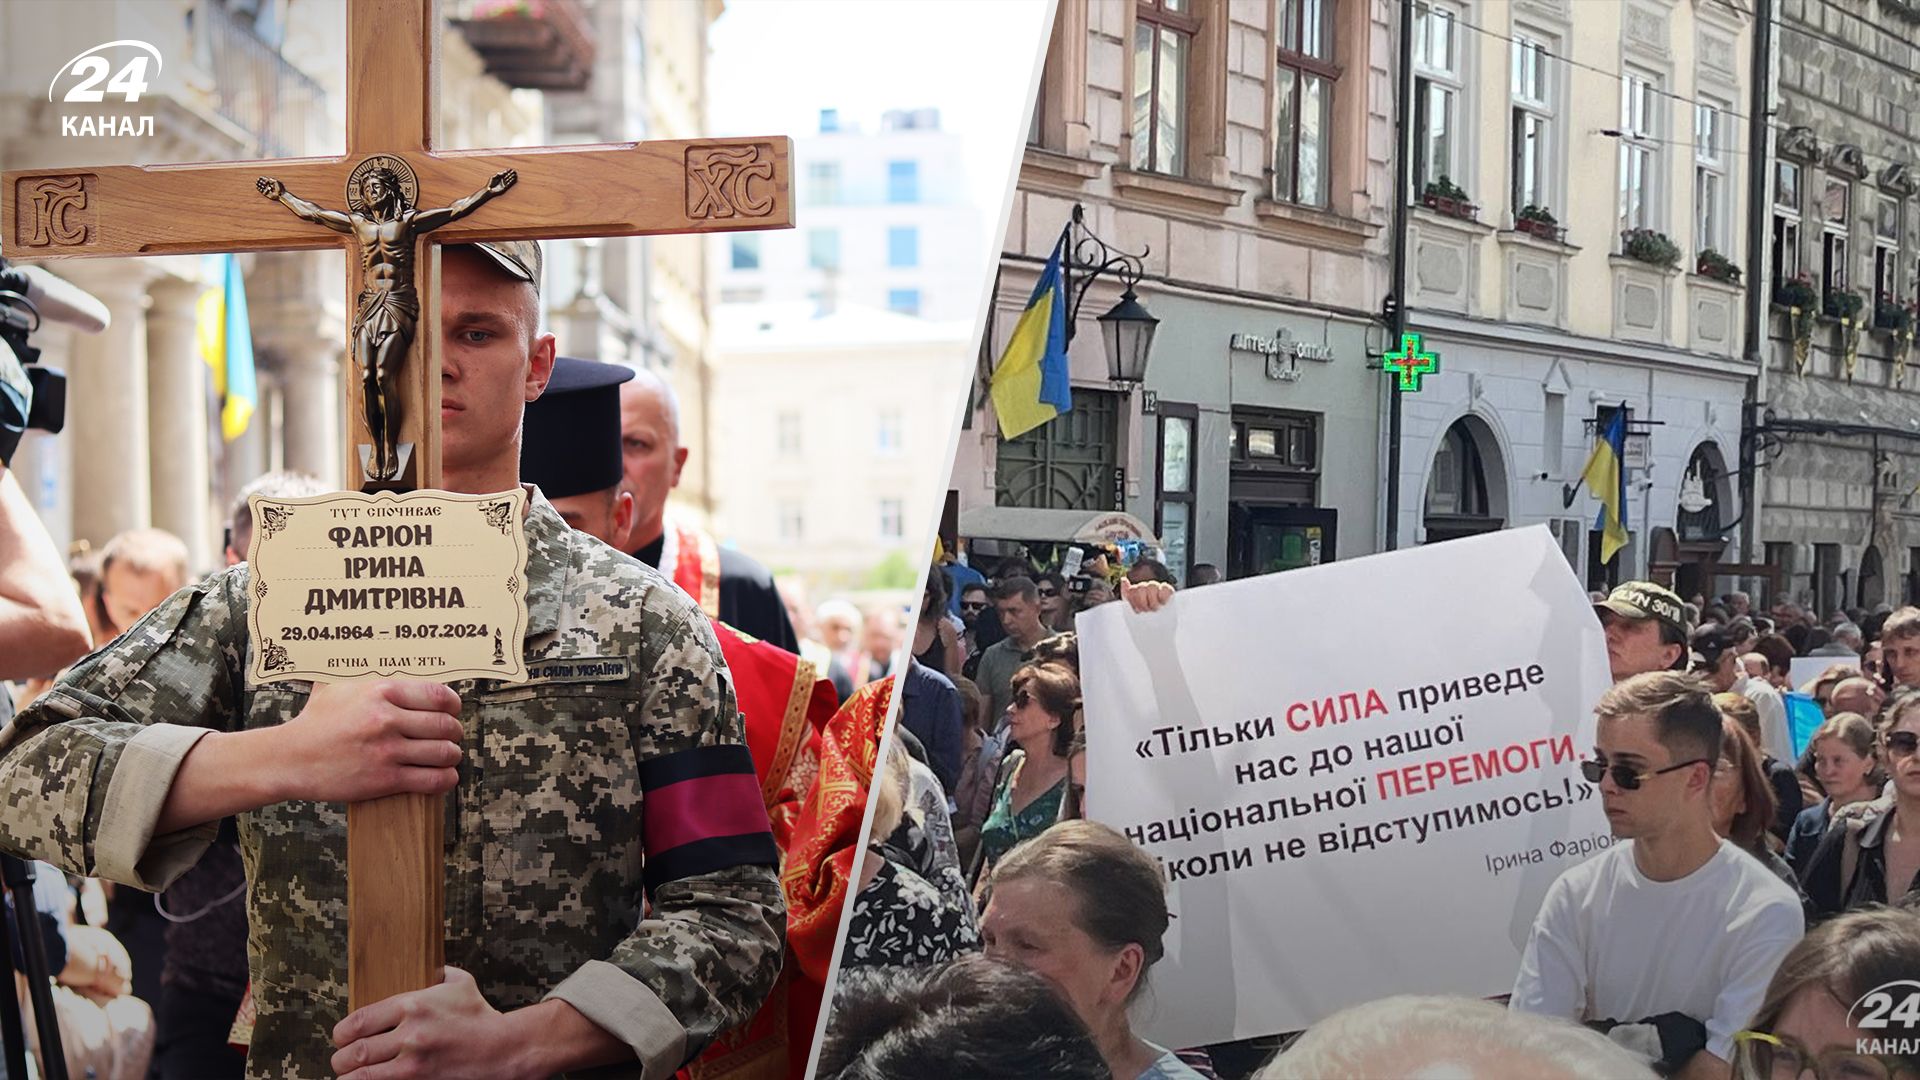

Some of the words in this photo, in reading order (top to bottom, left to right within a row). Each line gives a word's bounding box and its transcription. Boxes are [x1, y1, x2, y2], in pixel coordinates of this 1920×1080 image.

[1144, 392, 1155, 411] 12
[330, 508, 360, 520] ТУТ
[367, 506, 442, 517] СПОЧИВАЄ
[328, 525, 432, 548] ФАРІОН
[344, 556, 425, 579] ІРИНА
[305, 587, 465, 615] ДМИТРІВНА
[281, 625, 374, 641] 29.04.1964
[395, 624, 489, 639] 19.07.2024
[327, 658, 369, 668] ВІЧНА
[543, 666, 573, 678] СИЛИ
[576, 662, 624, 676] УКРАЇНИ
[1135, 716, 1275, 758] «Тільки
[1286, 688, 1388, 732] СИЛА
[1398, 664, 1545, 714] приведе
[1235, 755, 1298, 784] нас
[1309, 744, 1353, 776] до
[1364, 714, 1464, 760] нашої
[1125, 777, 1366, 846] національної
[1376, 734, 1586, 800] ПЕРЕМОГИ.
[1157, 847, 1253, 881] іколи
[1265, 838, 1306, 863] не
[1319, 778, 1594, 853] відступимось!»
[1485, 848, 1544, 876] Ірина
